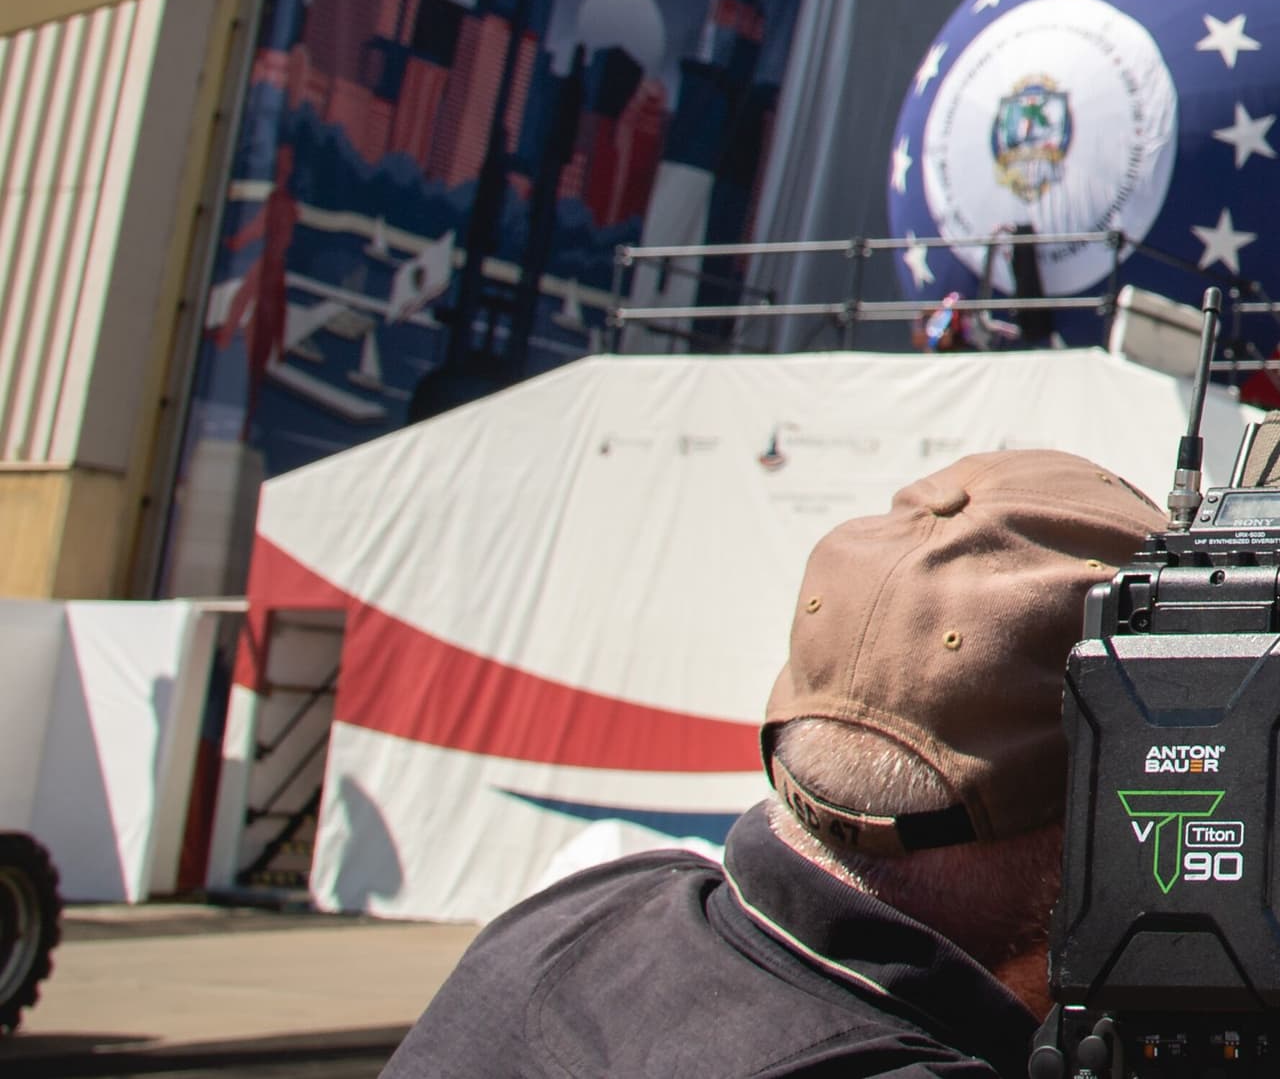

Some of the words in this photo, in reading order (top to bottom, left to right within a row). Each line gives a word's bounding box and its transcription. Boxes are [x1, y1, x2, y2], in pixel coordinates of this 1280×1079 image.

[1232, 518, 1274, 526] SONY
[1145, 759, 1218, 773] BAUER
[1191, 827, 1236, 842] Titon
[1184, 852, 1243, 881] 90
